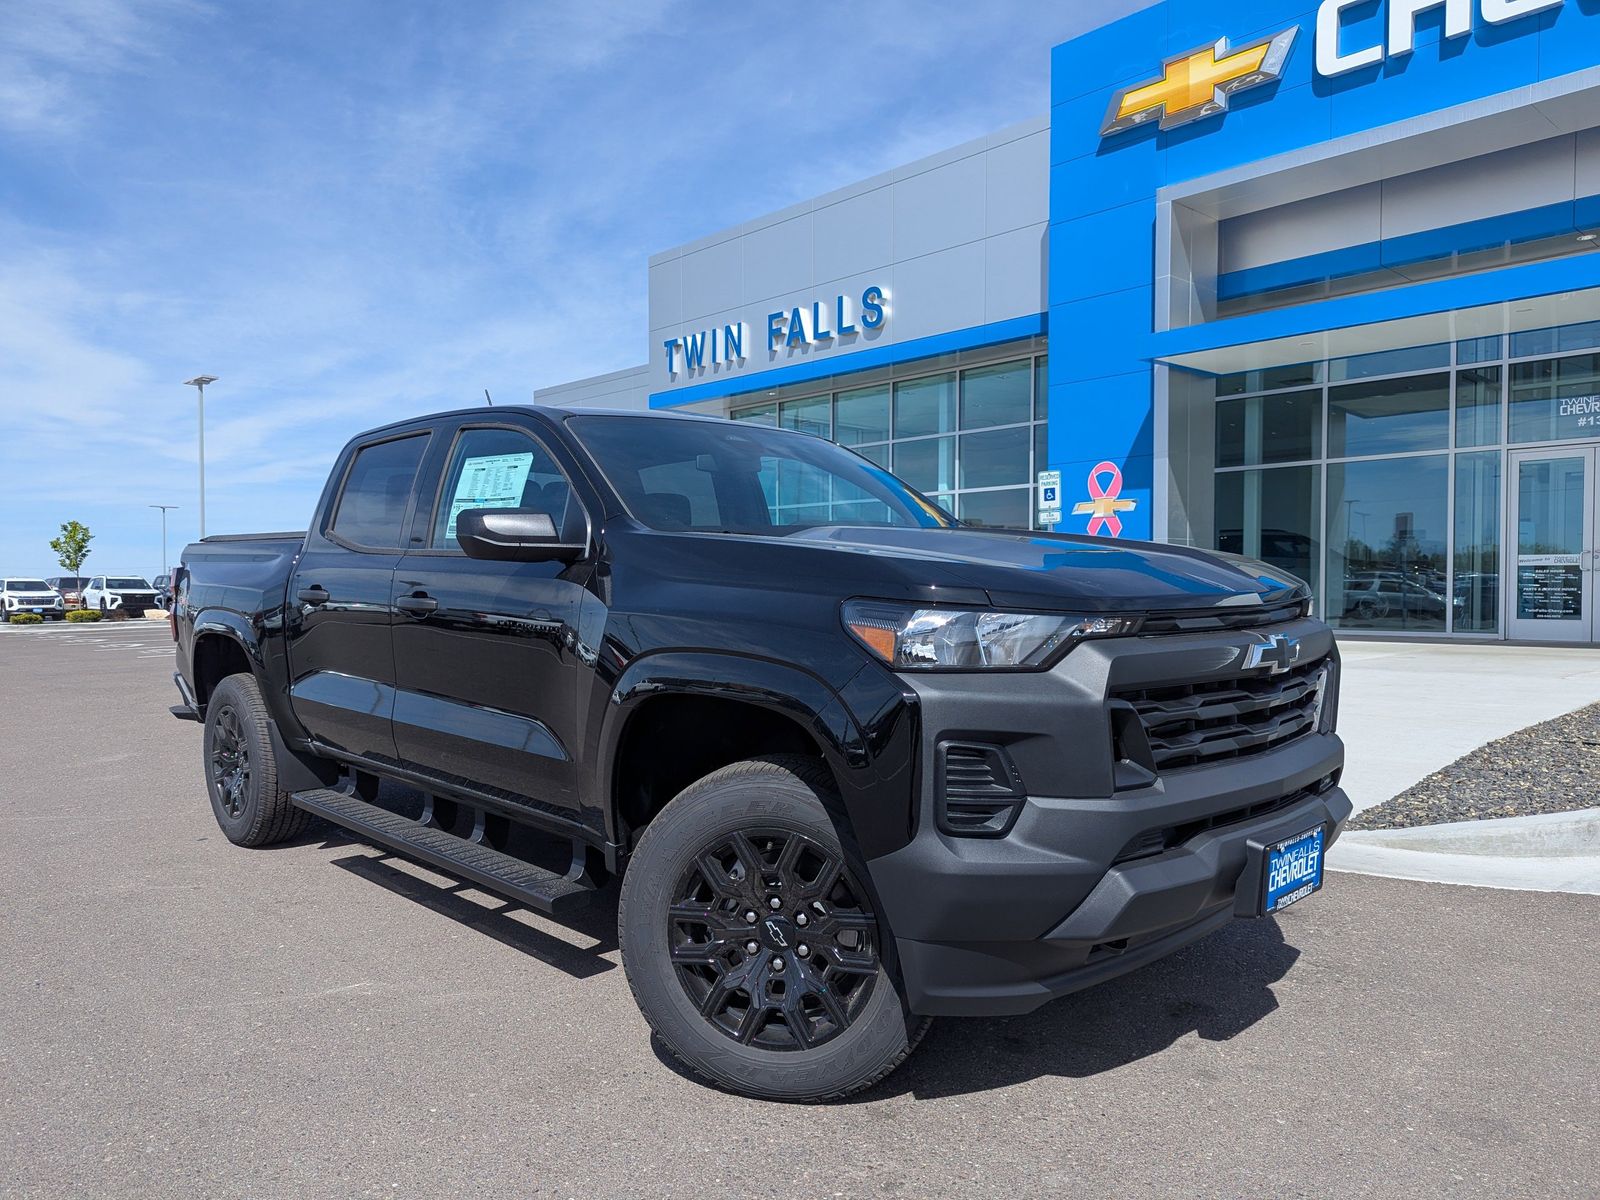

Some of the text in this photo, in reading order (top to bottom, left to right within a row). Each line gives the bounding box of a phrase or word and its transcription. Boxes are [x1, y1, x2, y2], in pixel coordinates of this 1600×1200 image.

[664, 286, 886, 375] TWIN FALLS
[1269, 852, 1319, 892] CHEVROLET
[1271, 840, 1320, 872] TWINFALLS
